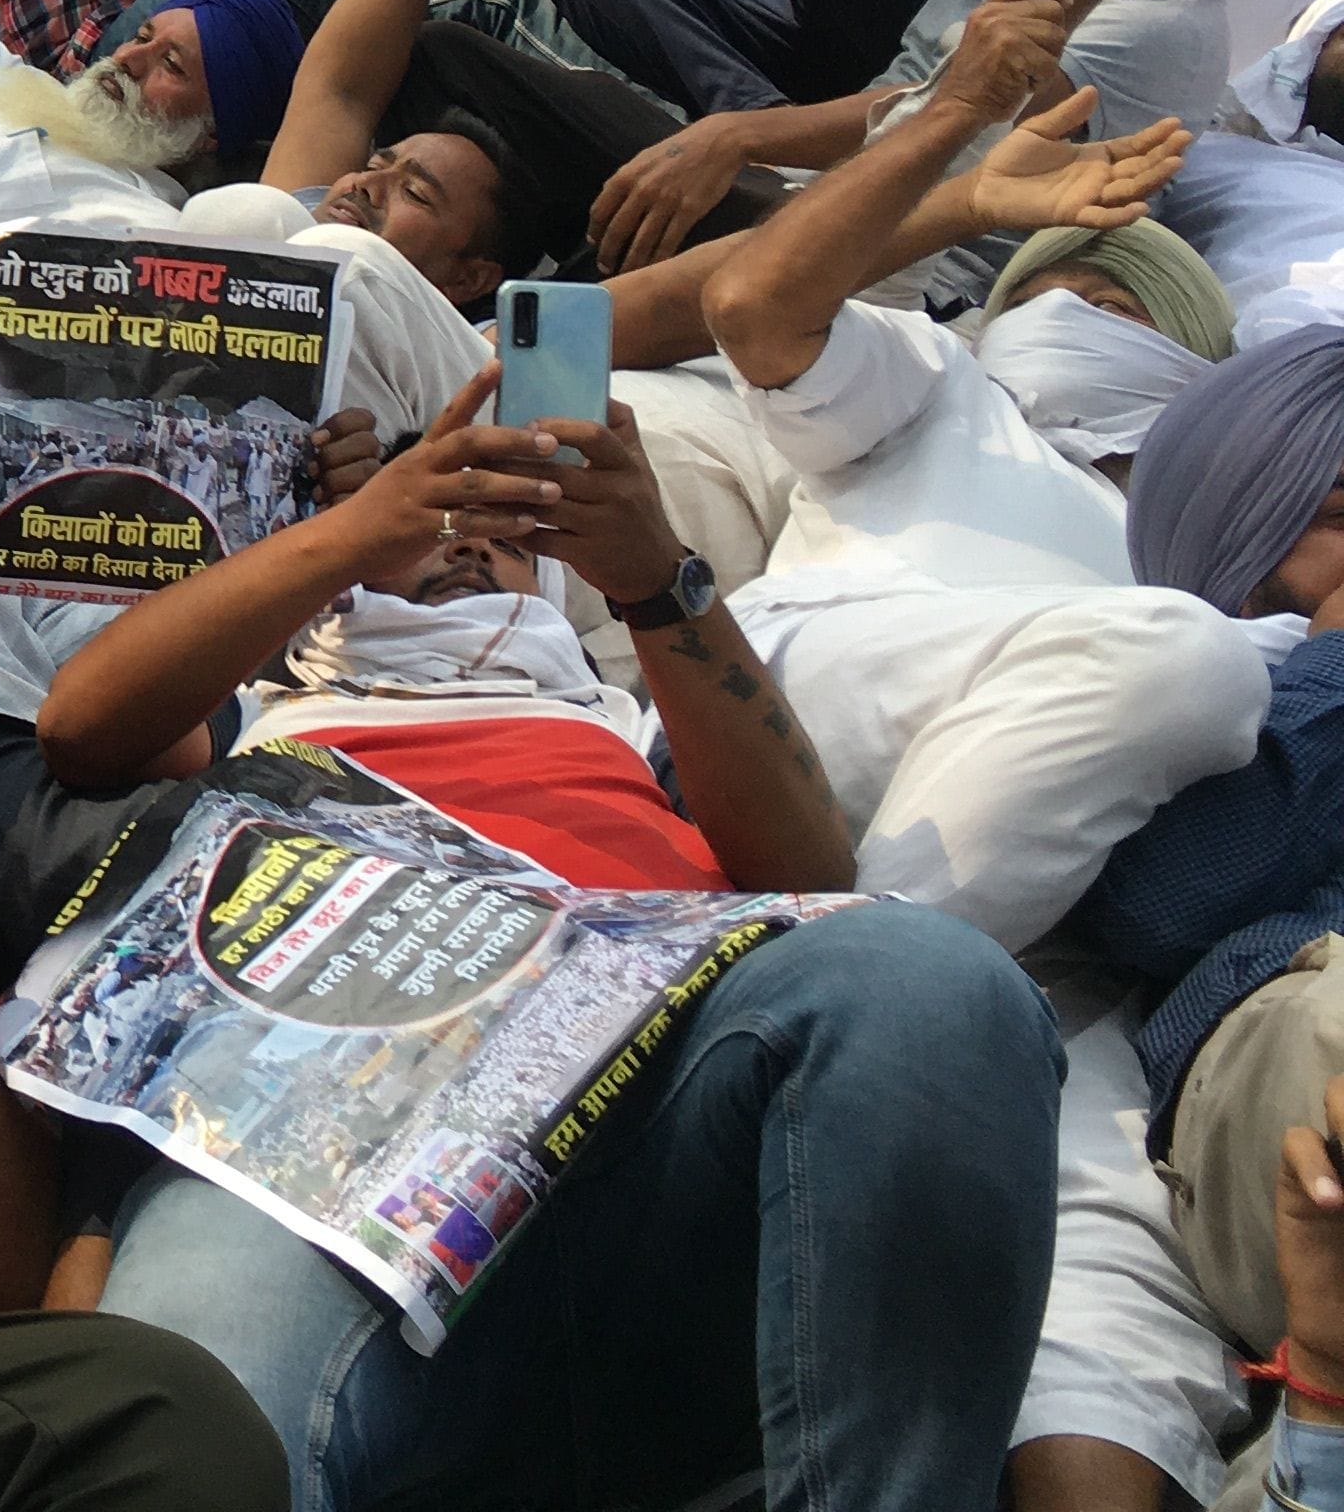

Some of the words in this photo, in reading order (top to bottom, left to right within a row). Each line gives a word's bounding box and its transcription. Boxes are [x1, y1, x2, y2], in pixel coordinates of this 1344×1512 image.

[26, 261, 88, 300] खुद
[92, 259, 132, 297] को
[132, 255, 227, 304] गब्बर
[225, 276, 325, 320] कहलाता,
[116, 315, 164, 348] पर
[167, 314, 226, 356] लाठी
[223, 325, 324, 365] चलवाता
[20, 505, 116, 545] किसानों
[116, 513, 149, 547] को
[150, 516, 203, 551] मारी
[12, 548, 58, 571] लाठी
[61, 554, 89, 573] का
[92, 552, 149, 578] हिसाब
[152, 555, 185, 582] देना
[210, 839, 301, 926] किसानों
[338, 876, 371, 901] का
[216, 940, 249, 967] हर
[241, 900, 291, 940] लाठी
[282, 881, 314, 907] का
[308, 952, 358, 997] धरती
[368, 909, 399, 932] के
[392, 880, 434, 913] खून
[370, 931, 426, 980] अपना
[413, 906, 450, 933] रंग
[544, 1111, 586, 1161] हम
[577, 1046, 642, 1122] अपना
